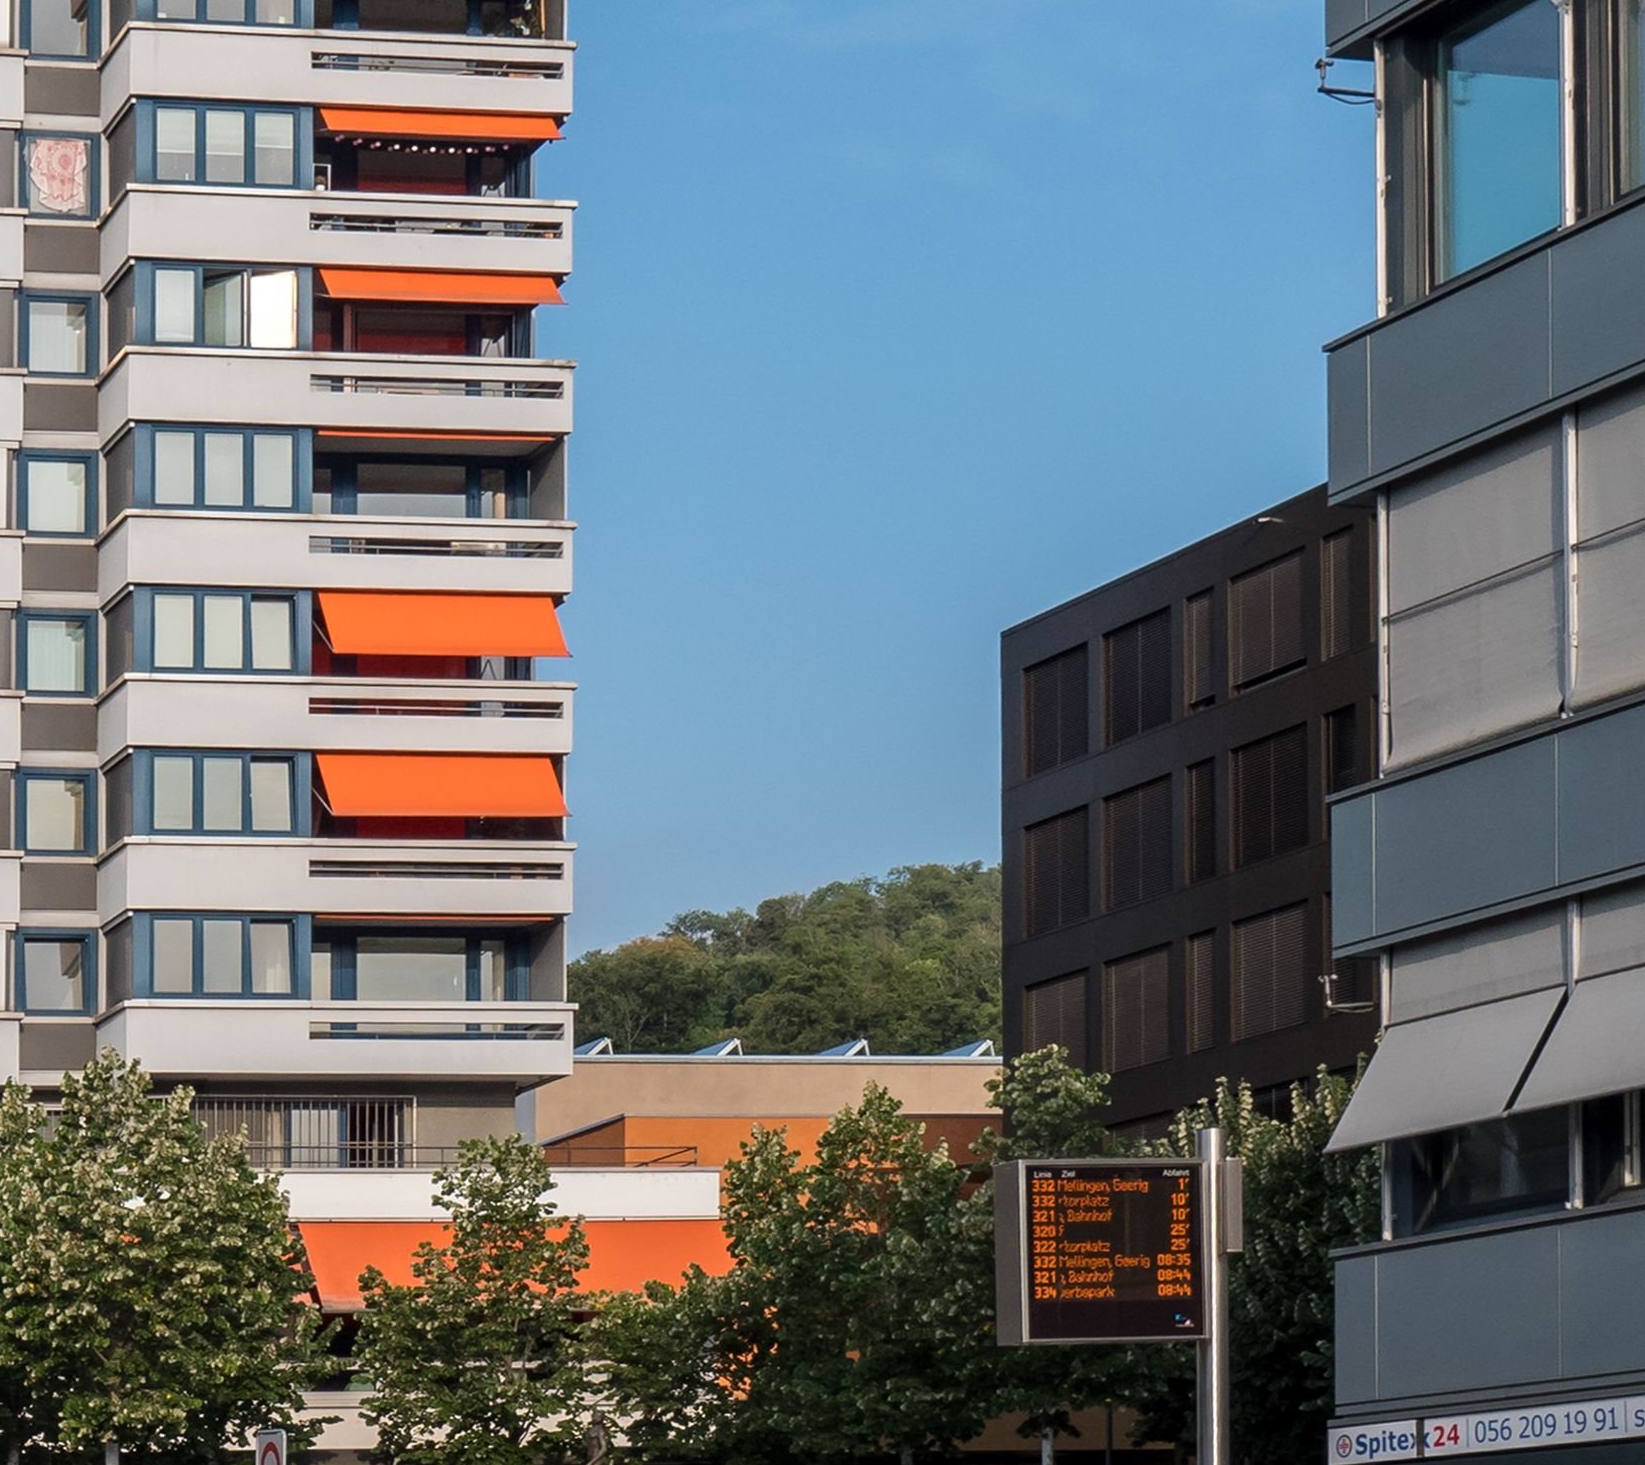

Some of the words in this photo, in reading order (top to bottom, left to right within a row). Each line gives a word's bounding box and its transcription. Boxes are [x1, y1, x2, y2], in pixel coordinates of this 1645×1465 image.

[1061, 1170, 1076, 1178] Ziel
[1162, 1169, 1190, 1177] Abfahrt
[1032, 1180, 1056, 1192] 332
[1032, 1195, 1056, 1207] 332
[1171, 1193, 1190, 1205] 10'
[1032, 1210, 1055, 1223] 321
[1172, 1208, 1190, 1221] 10'
[1033, 1225, 1056, 1237] 320
[1171, 1223, 1190, 1236] 25'
[1033, 1241, 1056, 1253] 322
[1171, 1238, 1190, 1251] 25'
[1033, 1256, 1056, 1268] 332
[1157, 1253, 1191, 1266] 08:35
[1034, 1271, 1056, 1284] 321
[1157, 1269, 1191, 1281] 08:44
[1034, 1286, 1057, 1299] 334
[1158, 1284, 1192, 1297] 08:44
[1355, 1428, 1430, 1459] Spitex
[1433, 1423, 1460, 1448] 24
[1474, 1418, 1511, 1443] 056
[1519, 1412, 1557, 1439] 209
[1564, 1409, 1587, 1435] 19
[1593, 1406, 1619, 1432] 91
